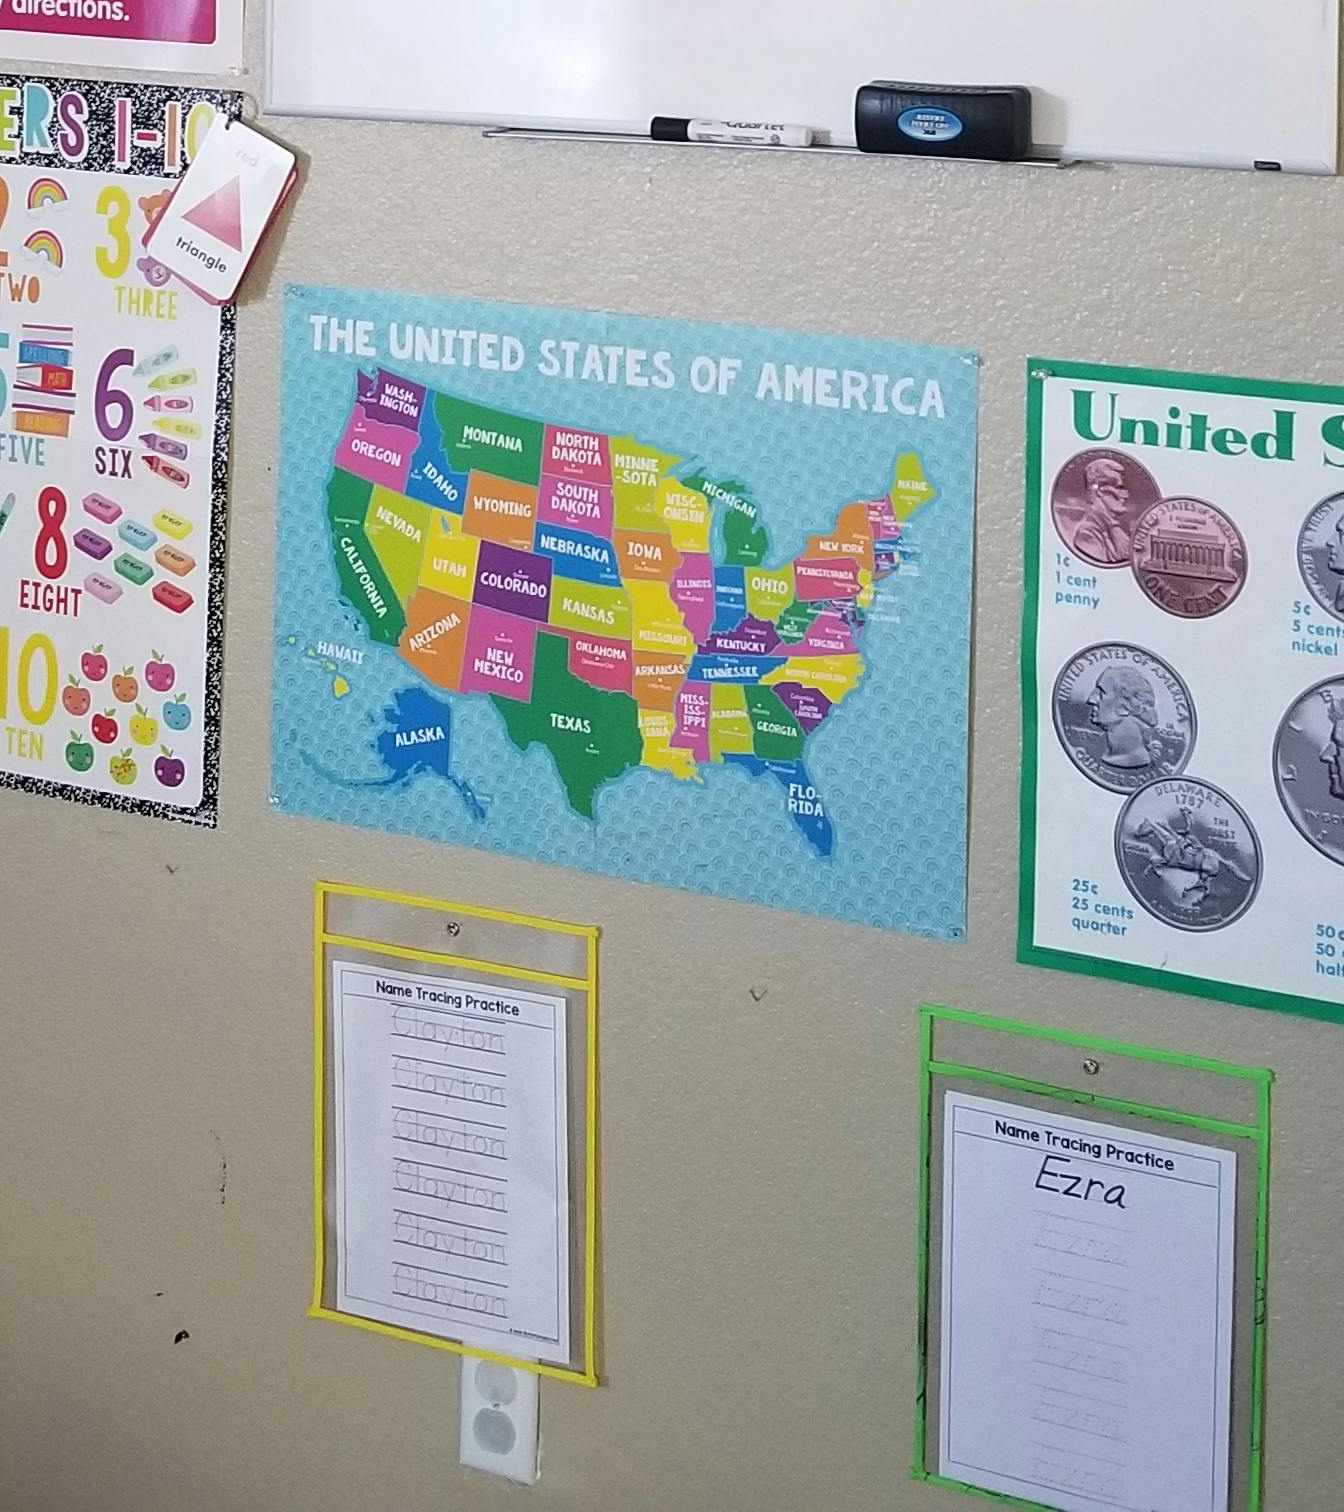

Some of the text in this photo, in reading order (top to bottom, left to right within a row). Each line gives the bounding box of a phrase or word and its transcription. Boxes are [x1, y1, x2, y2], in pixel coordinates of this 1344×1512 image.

[176, 236, 227, 275] triangle
[115, 286, 178, 320] THREE
[310, 315, 946, 419] THE UNITED STATES OF AMERICA
[463, 425, 523, 452] MONTANA
[1070, 388, 1296, 462] United
[95, 446, 132, 478] SIX
[351, 439, 401, 467] OREGON
[473, 496, 532, 519] WYOMING
[540, 534, 610, 564] NEBRASKA
[20, 580, 82, 617] EIGHT
[480, 571, 547, 599] COLORADO
[752, 577, 788, 597] OHIO
[562, 598, 615, 626] KANSAS
[1056, 592, 1100, 609] penny
[317, 641, 364, 665] HAWAII
[715, 637, 766, 654] KENTUCKY
[1292, 639, 1338, 656] nickel
[395, 725, 445, 747] ALASKA
[550, 714, 592, 734] TEXAS
[6, 727, 43, 759] TEN
[1072, 918, 1127, 936] quarter
[376, 981, 520, 1017] Name Tracing Practice
[994, 1120, 1175, 1171] Name Tracing Practice
[1034, 1155, 1127, 1209] Ezra
